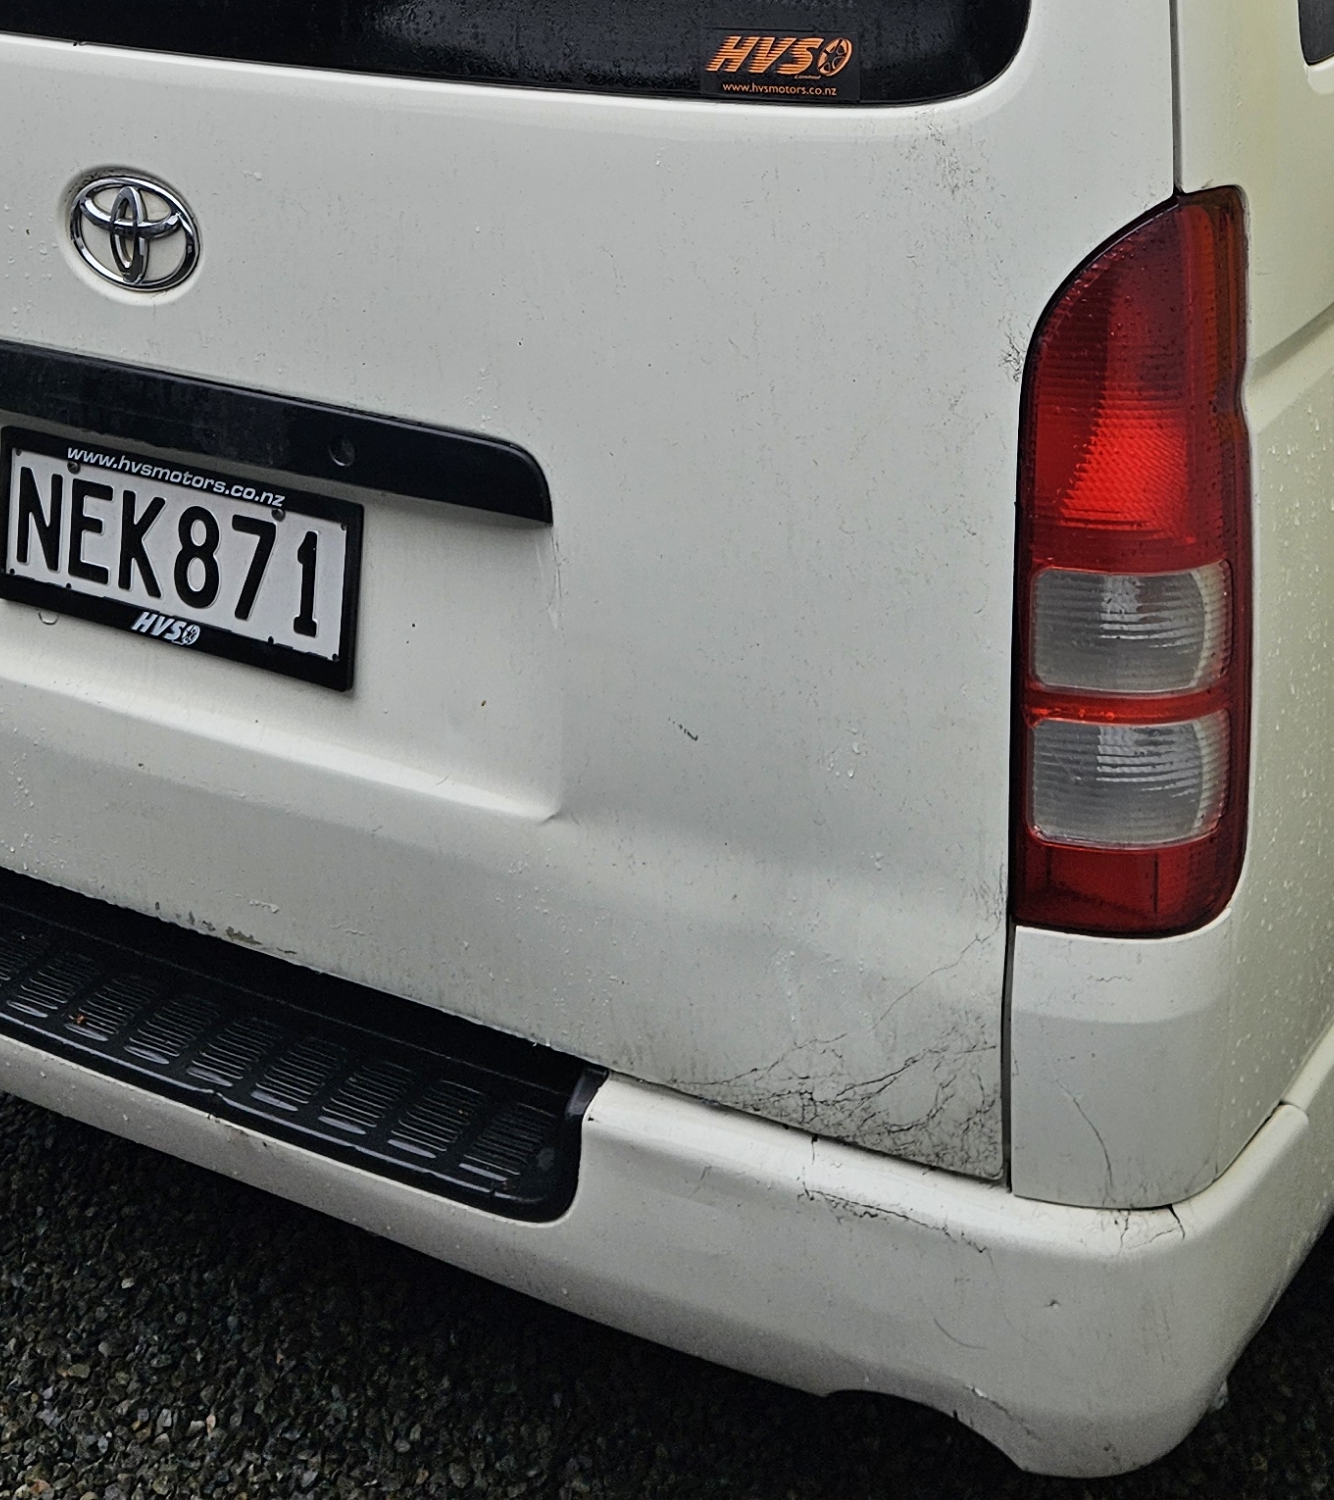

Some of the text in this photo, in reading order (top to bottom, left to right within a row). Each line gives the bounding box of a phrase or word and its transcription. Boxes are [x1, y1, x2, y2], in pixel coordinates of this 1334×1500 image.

[705, 35, 824, 75] HVS
[722, 82, 837, 96] www.hvsmotors.co.nz
[67, 447, 285, 508] www.hvsmotors.co.nz
[16, 466, 318, 638] NEK871
[131, 611, 187, 641] HVS
